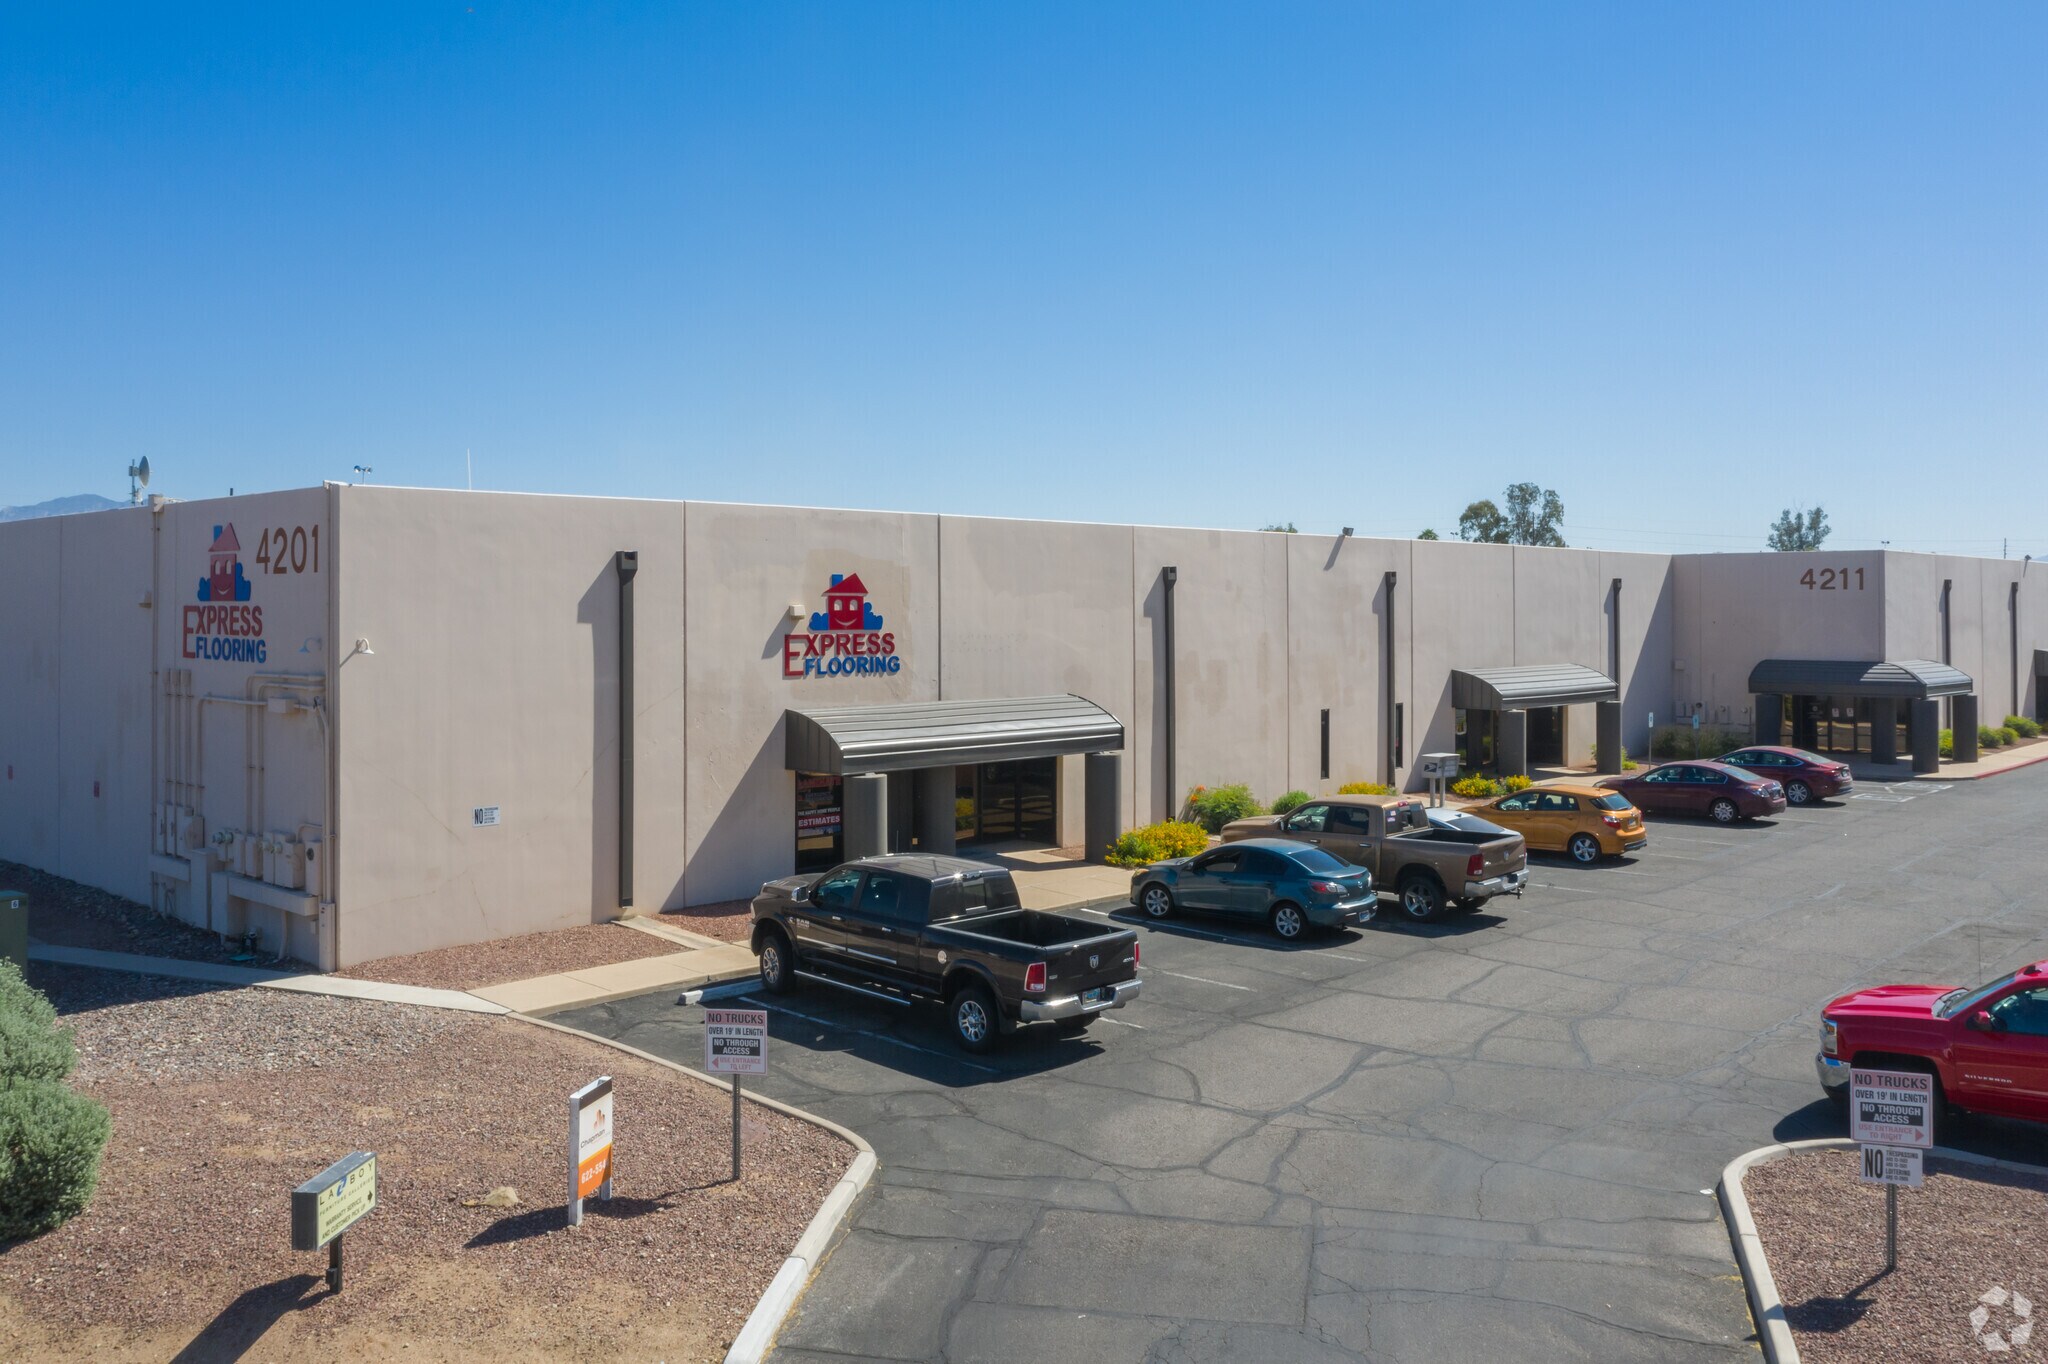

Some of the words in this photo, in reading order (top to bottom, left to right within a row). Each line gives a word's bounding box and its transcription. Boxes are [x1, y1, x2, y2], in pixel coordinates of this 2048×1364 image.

[256, 524, 319, 575] 4201
[1800, 567, 1864, 590] 4211
[182, 605, 263, 659] EXPRESS
[195, 636, 267, 664] FLOORING
[784, 632, 896, 676] EXPRESS
[804, 655, 900, 676] FLOORING
[474, 808, 484, 824] NO
[798, 815, 840, 827] ESTIMATES
[708, 1013, 722, 1023] NO
[725, 1013, 764, 1024] TRUCKS
[709, 1026, 724, 1035] OVER
[735, 1027, 742, 1036] IN
[742, 1028, 764, 1037] LENGTH
[713, 1038, 725, 1046] NO
[726, 1039, 759, 1048] THROUGH
[722, 1047, 750, 1055] ACCESS
[1854, 1073, 1872, 1085] NO
[1876, 1075, 1928, 1090] TRUCKS
[1855, 1089, 1874, 1099] OVER
[1877, 1091, 1888, 1100] 19'
[1890, 1092, 1898, 1101] IN
[1900, 1092, 1928, 1104] LENGTH
[1862, 1103, 1875, 1112] NO
[1877, 1104, 1921, 1116] THROUGH
[1873, 1113, 1910, 1124] ACCESS
[1875, 1124, 1913, 1134] ENTRANCE
[1880, 1132, 1903, 1140] RIGHT
[580, 1129, 606, 1149] Chapman
[1864, 1148, 1883, 1179] NO
[346, 1197, 362, 1212] SERVICE
[322, 1229, 331, 1240] AND
[331, 1215, 351, 1235] CUSTOMER
[351, 1208, 360, 1217] PICK
